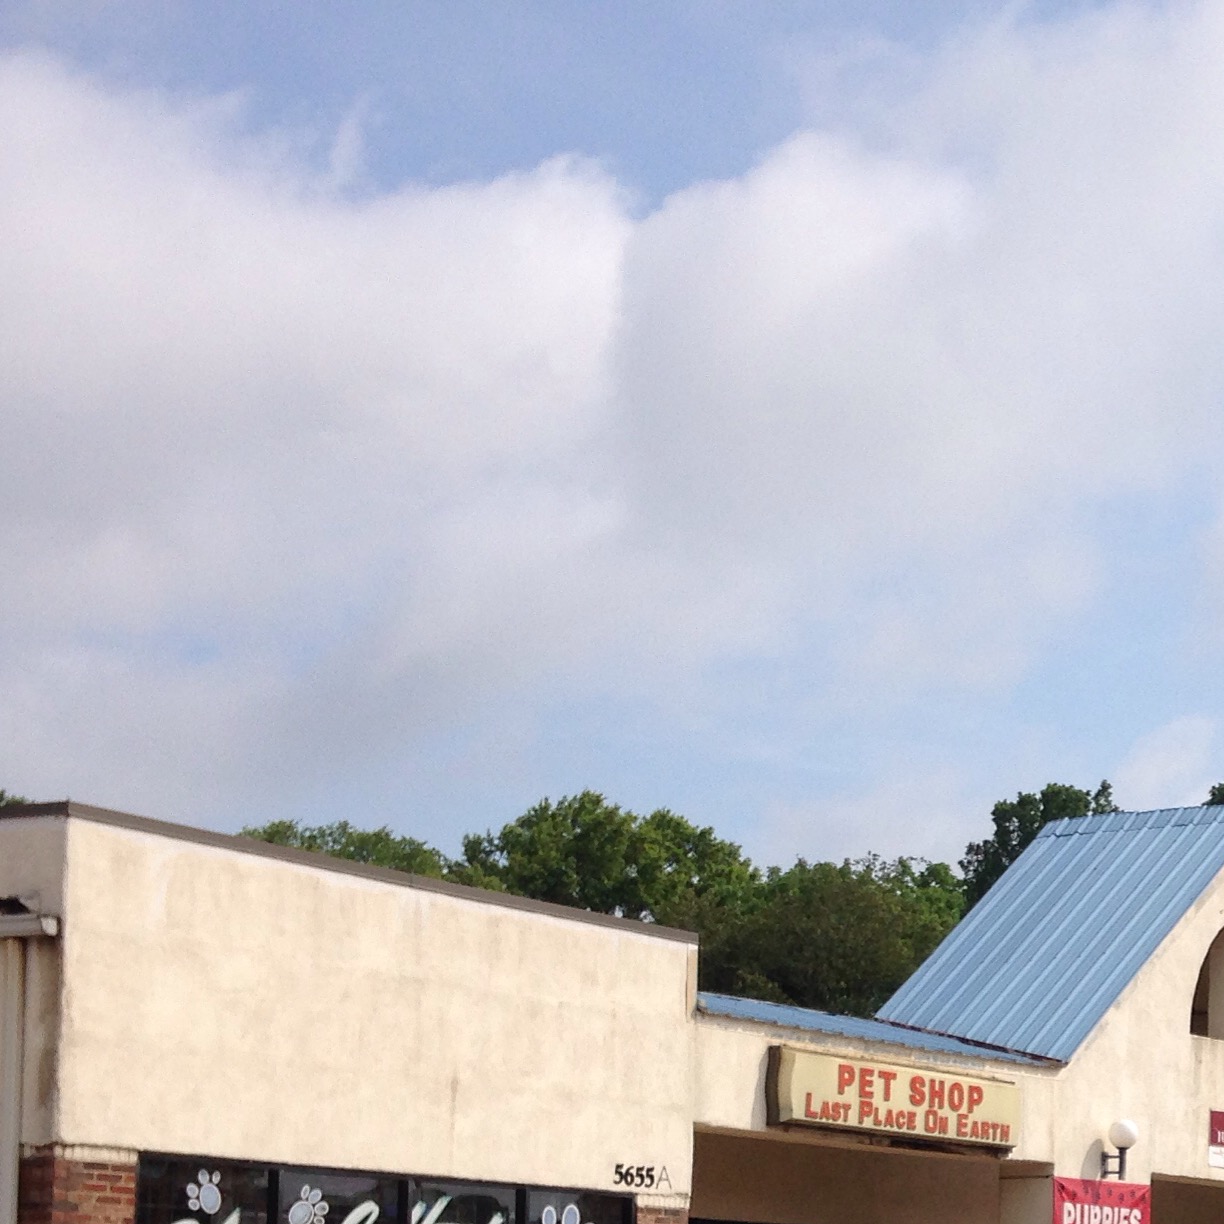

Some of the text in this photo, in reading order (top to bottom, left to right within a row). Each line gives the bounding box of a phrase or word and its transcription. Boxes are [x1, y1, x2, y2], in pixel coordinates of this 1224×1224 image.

[838, 1064, 984, 1113] PET SHOP
[804, 1092, 1011, 1142] LAST PLACE ON EARTH
